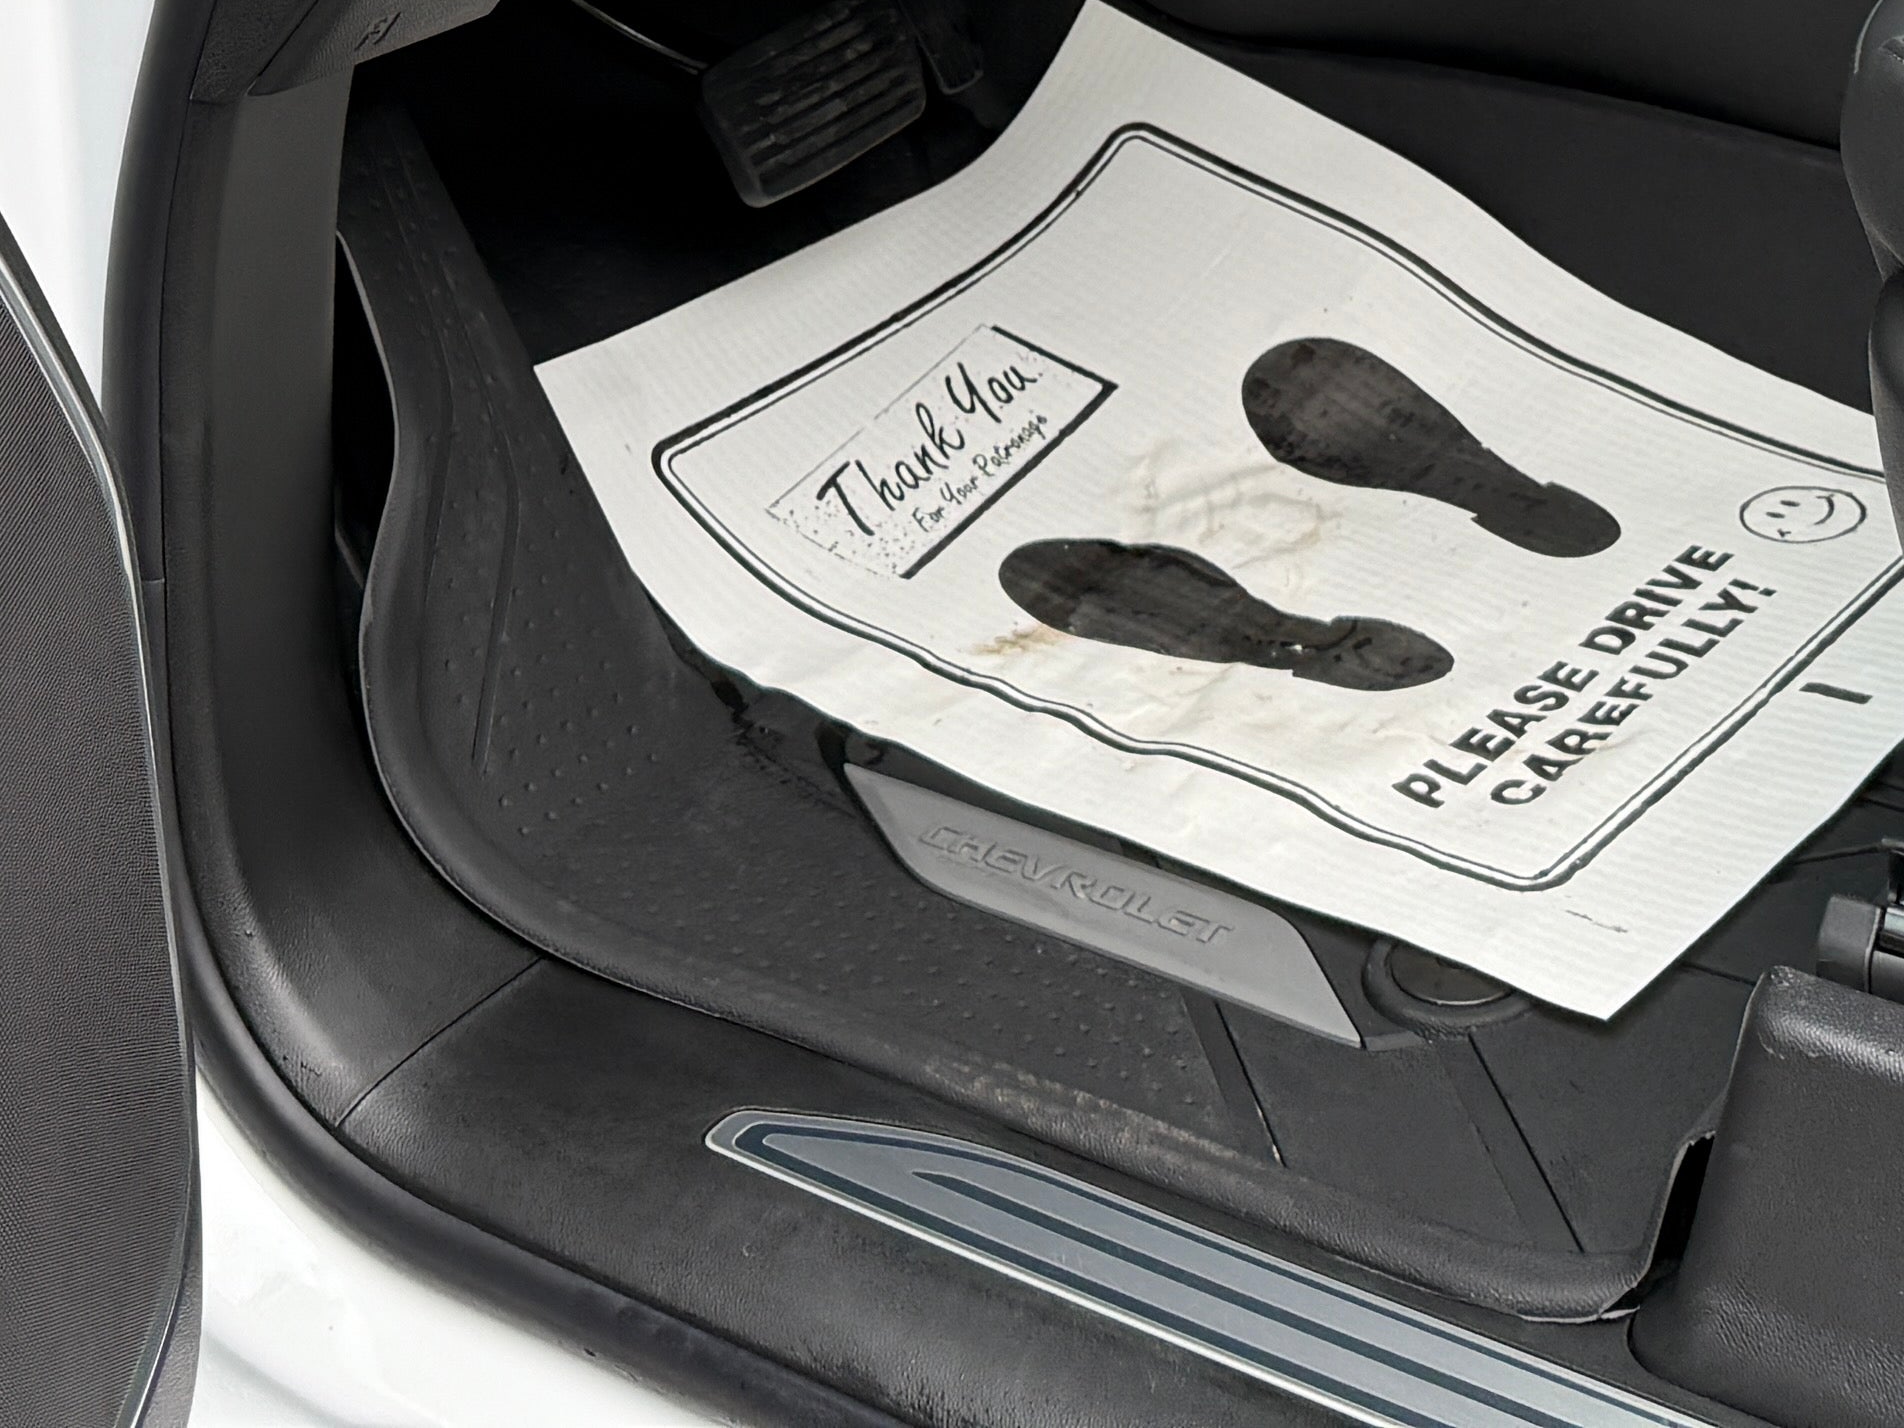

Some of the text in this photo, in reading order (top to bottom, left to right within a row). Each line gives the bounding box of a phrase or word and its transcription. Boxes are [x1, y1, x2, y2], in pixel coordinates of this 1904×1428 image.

[815, 361, 1038, 537] Thank You
[911, 505, 945, 533] For
[939, 475, 978, 505] Your
[1391, 544, 1734, 809] PLEASE DRIVE
[1489, 578, 1777, 806] CAREFULLY!
[917, 825, 1235, 945] CHEVROLET
